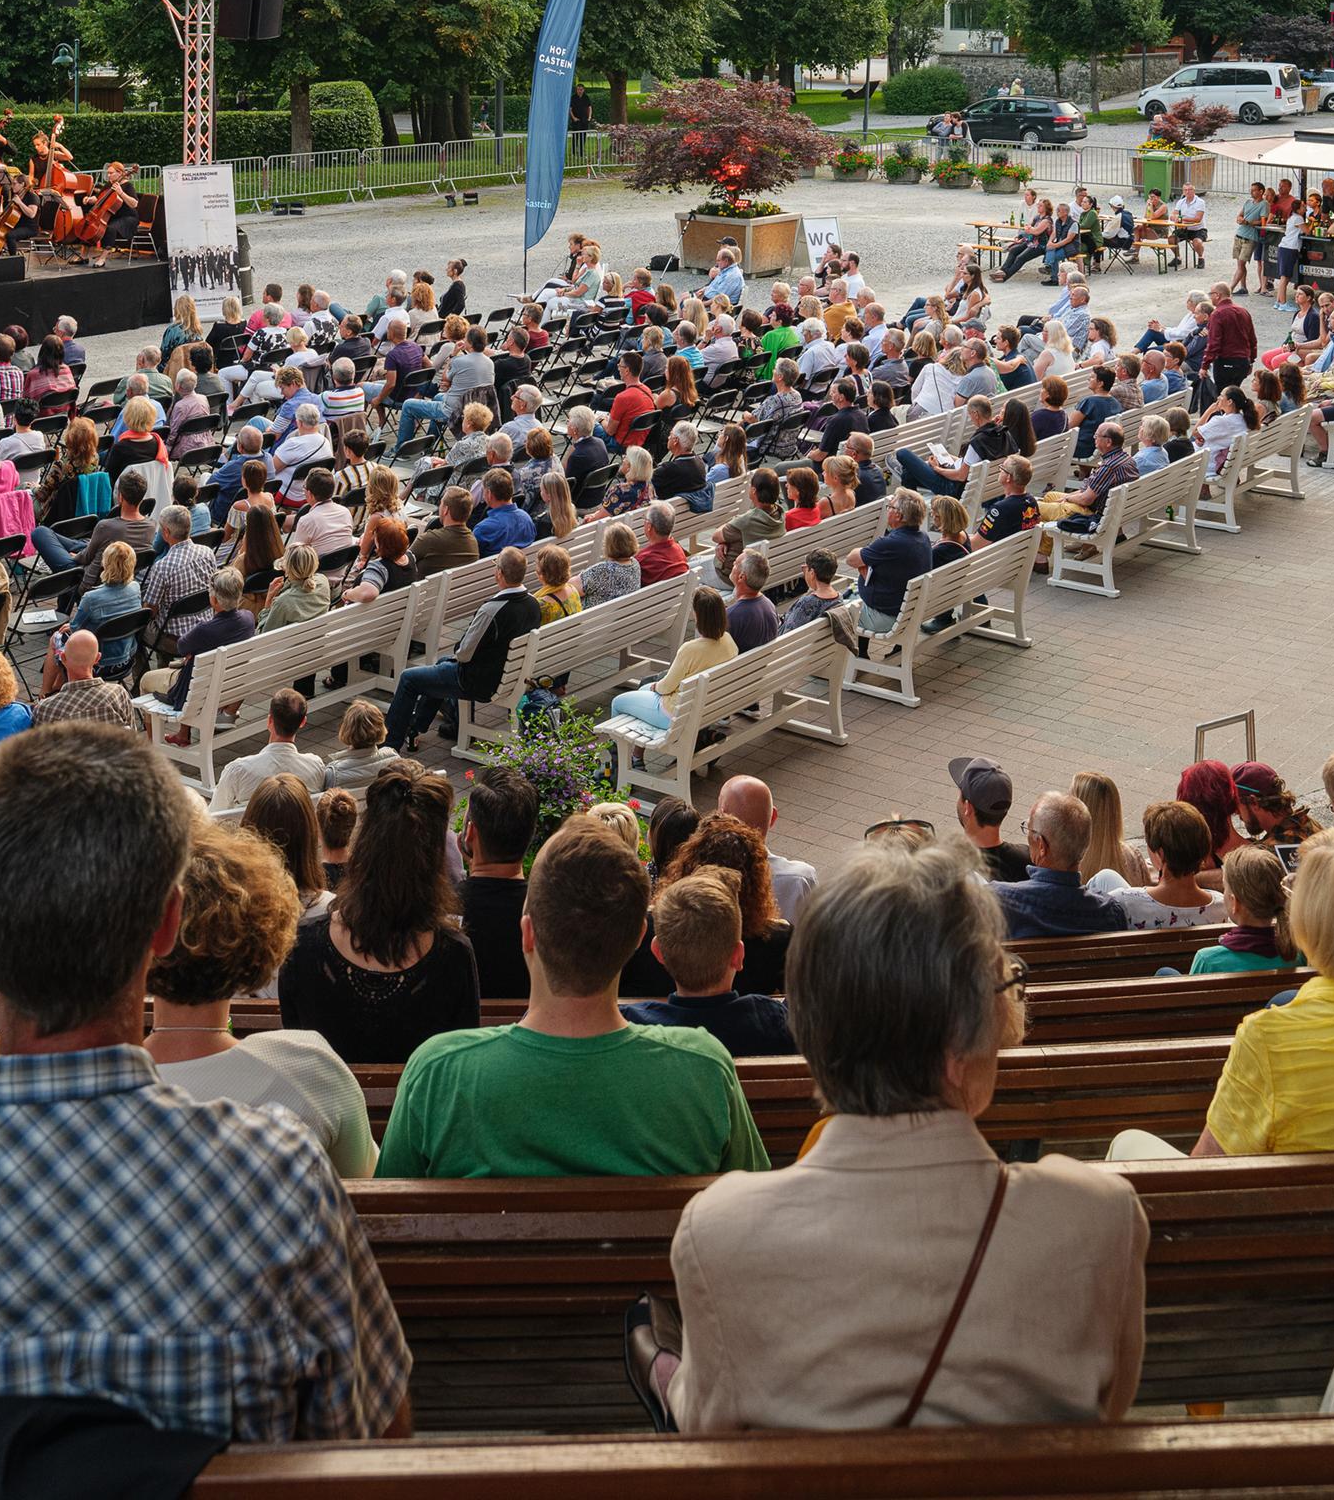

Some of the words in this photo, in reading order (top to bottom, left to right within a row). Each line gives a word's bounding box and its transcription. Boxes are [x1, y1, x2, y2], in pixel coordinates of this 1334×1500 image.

[549, 45, 567, 56] HOF
[538, 53, 573, 69] GASTEIN
[808, 232, 835, 246] WC
